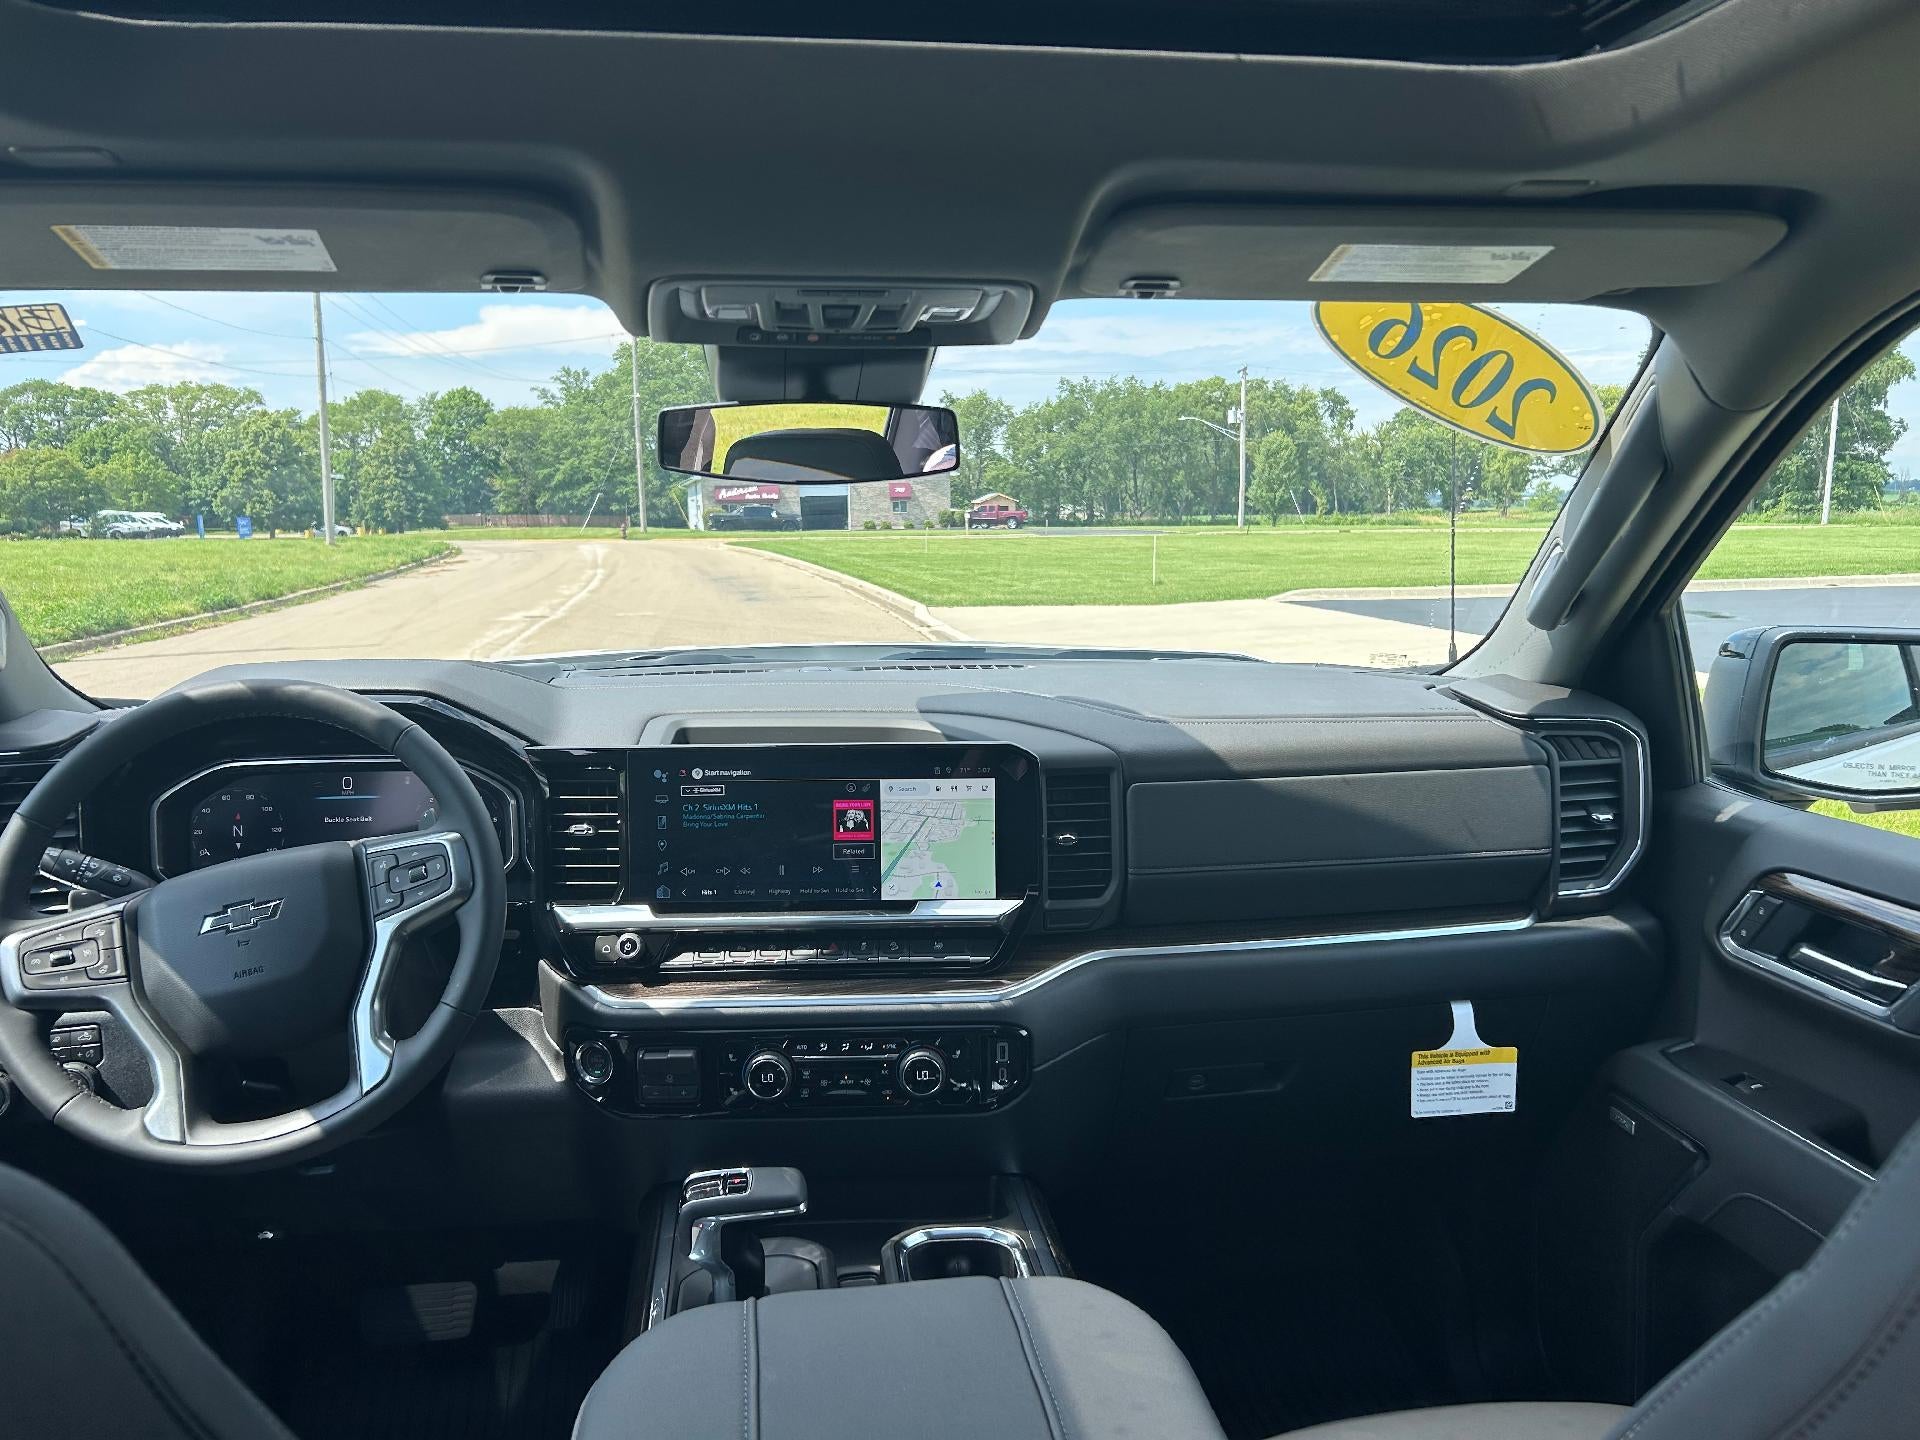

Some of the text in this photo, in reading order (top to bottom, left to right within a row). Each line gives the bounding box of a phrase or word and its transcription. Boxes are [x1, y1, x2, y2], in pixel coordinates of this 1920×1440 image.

[1842, 761, 1874, 770] OBJECTS
[704, 769, 752, 778] Start navigation
[1867, 770, 1888, 778] THAN
[342, 776, 353, 790] 0
[703, 803, 736, 811] SiriusXM
[737, 803, 752, 811] Hits
[232, 824, 243, 837] N
[233, 965, 265, 980] AIRBAG
[1455, 1051, 1478, 1059] Equipped
[761, 1073, 774, 1083] LO
[916, 1070, 929, 1080] LO
